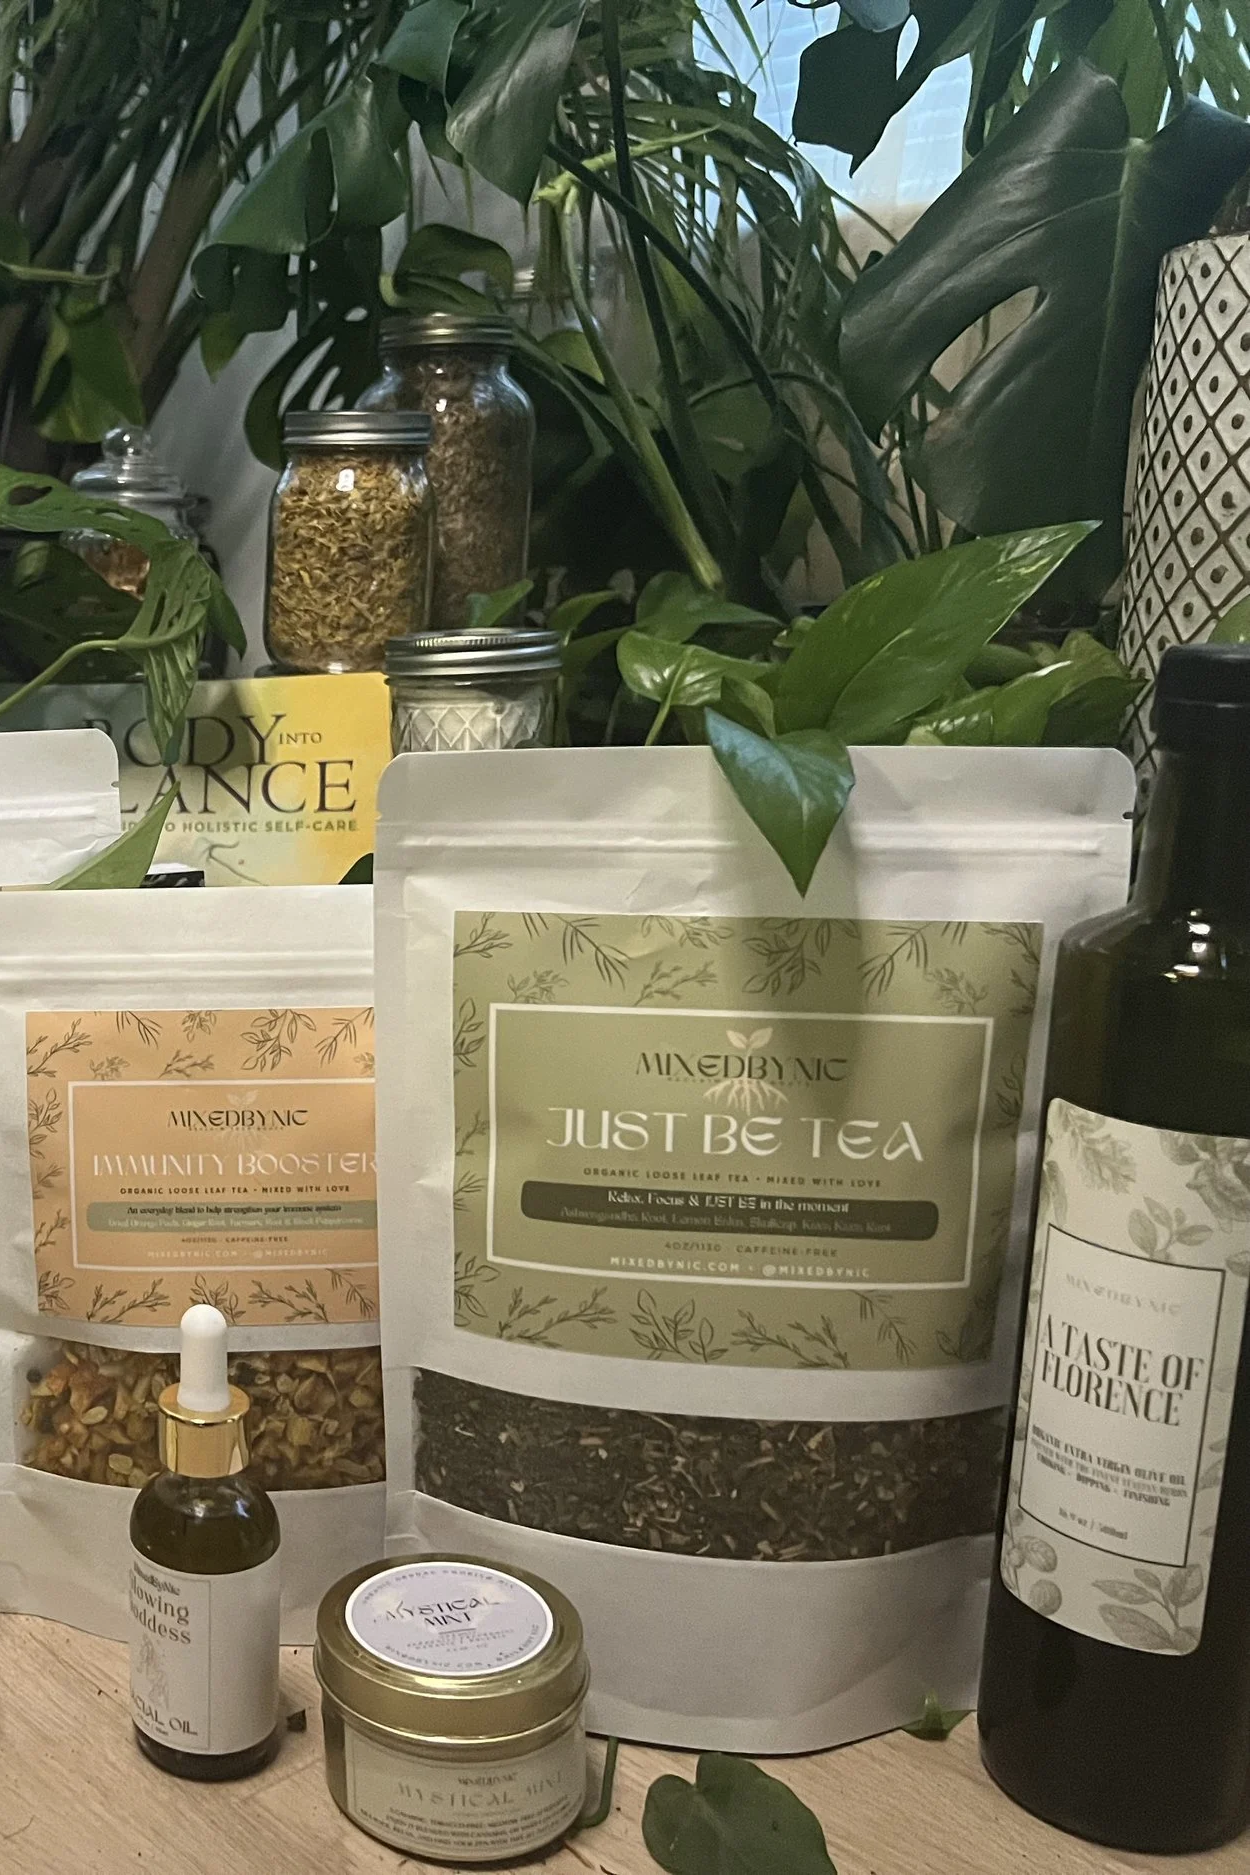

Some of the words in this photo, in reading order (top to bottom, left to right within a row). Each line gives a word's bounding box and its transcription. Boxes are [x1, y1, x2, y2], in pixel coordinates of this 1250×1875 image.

[279, 732, 322, 745] INTO
[183, 820, 257, 833] HOLISTIC
[265, 819, 358, 832] SELF-CARE
[636, 1052, 847, 1082] MIXEDBYNIC
[167, 1109, 308, 1128] MIXEDBYNIC
[546, 1108, 687, 1152] JUST
[703, 1114, 782, 1156] BE
[800, 1117, 924, 1162] TEA
[93, 1153, 228, 1176] IMMUNITY
[237, 1152, 377, 1175] BOOSTER
[583, 1167, 639, 1178] ORGANIC
[646, 1171, 685, 1180] LOOSE
[692, 1172, 721, 1182] LEAF
[728, 1174, 749, 1183] TEA
[766, 1175, 805, 1185] MIXED
[812, 1177, 844, 1187] WITH
[850, 1179, 881, 1188] LOVE
[120, 1187, 164, 1195] ORGANIC
[168, 1187, 199, 1195] LOOSE
[261, 1186, 291, 1194] MIXED
[297, 1185, 321, 1193] WITH
[175, 1205, 195, 1214] blend
[648, 1192, 684, 1206] Focus
[688, 1194, 699, 1207] &
[705, 1194, 735, 1208] JUST
[738, 1196, 756, 1209] BE
[760, 1198, 771, 1210] in
[775, 1199, 795, 1211] the
[797, 1202, 850, 1213] moment
[610, 1257, 740, 1272] MIXEDBYNIC.COM
[762, 1264, 870, 1278] @MIXEDBYNIC
[1040, 1314, 1053, 1349] A
[1062, 1321, 1152, 1383] TASTE
[1161, 1354, 1204, 1391] OF
[1042, 1349, 1183, 1426] FLORENCE
[1064, 1443, 1093, 1464] EXTRA
[1096, 1456, 1131, 1475] VIRGIN
[1134, 1467, 1166, 1483] OLIVE
[1168, 1474, 1185, 1486] OIL
[130, 1570, 189, 1626] lowing
[130, 1596, 191, 1645] oddess
[373, 1597, 500, 1623] MYSTICAL
[424, 1612, 471, 1626] MINT
[169, 1717, 198, 1736] OIL
[398, 1782, 512, 1807] MYSTICAL
